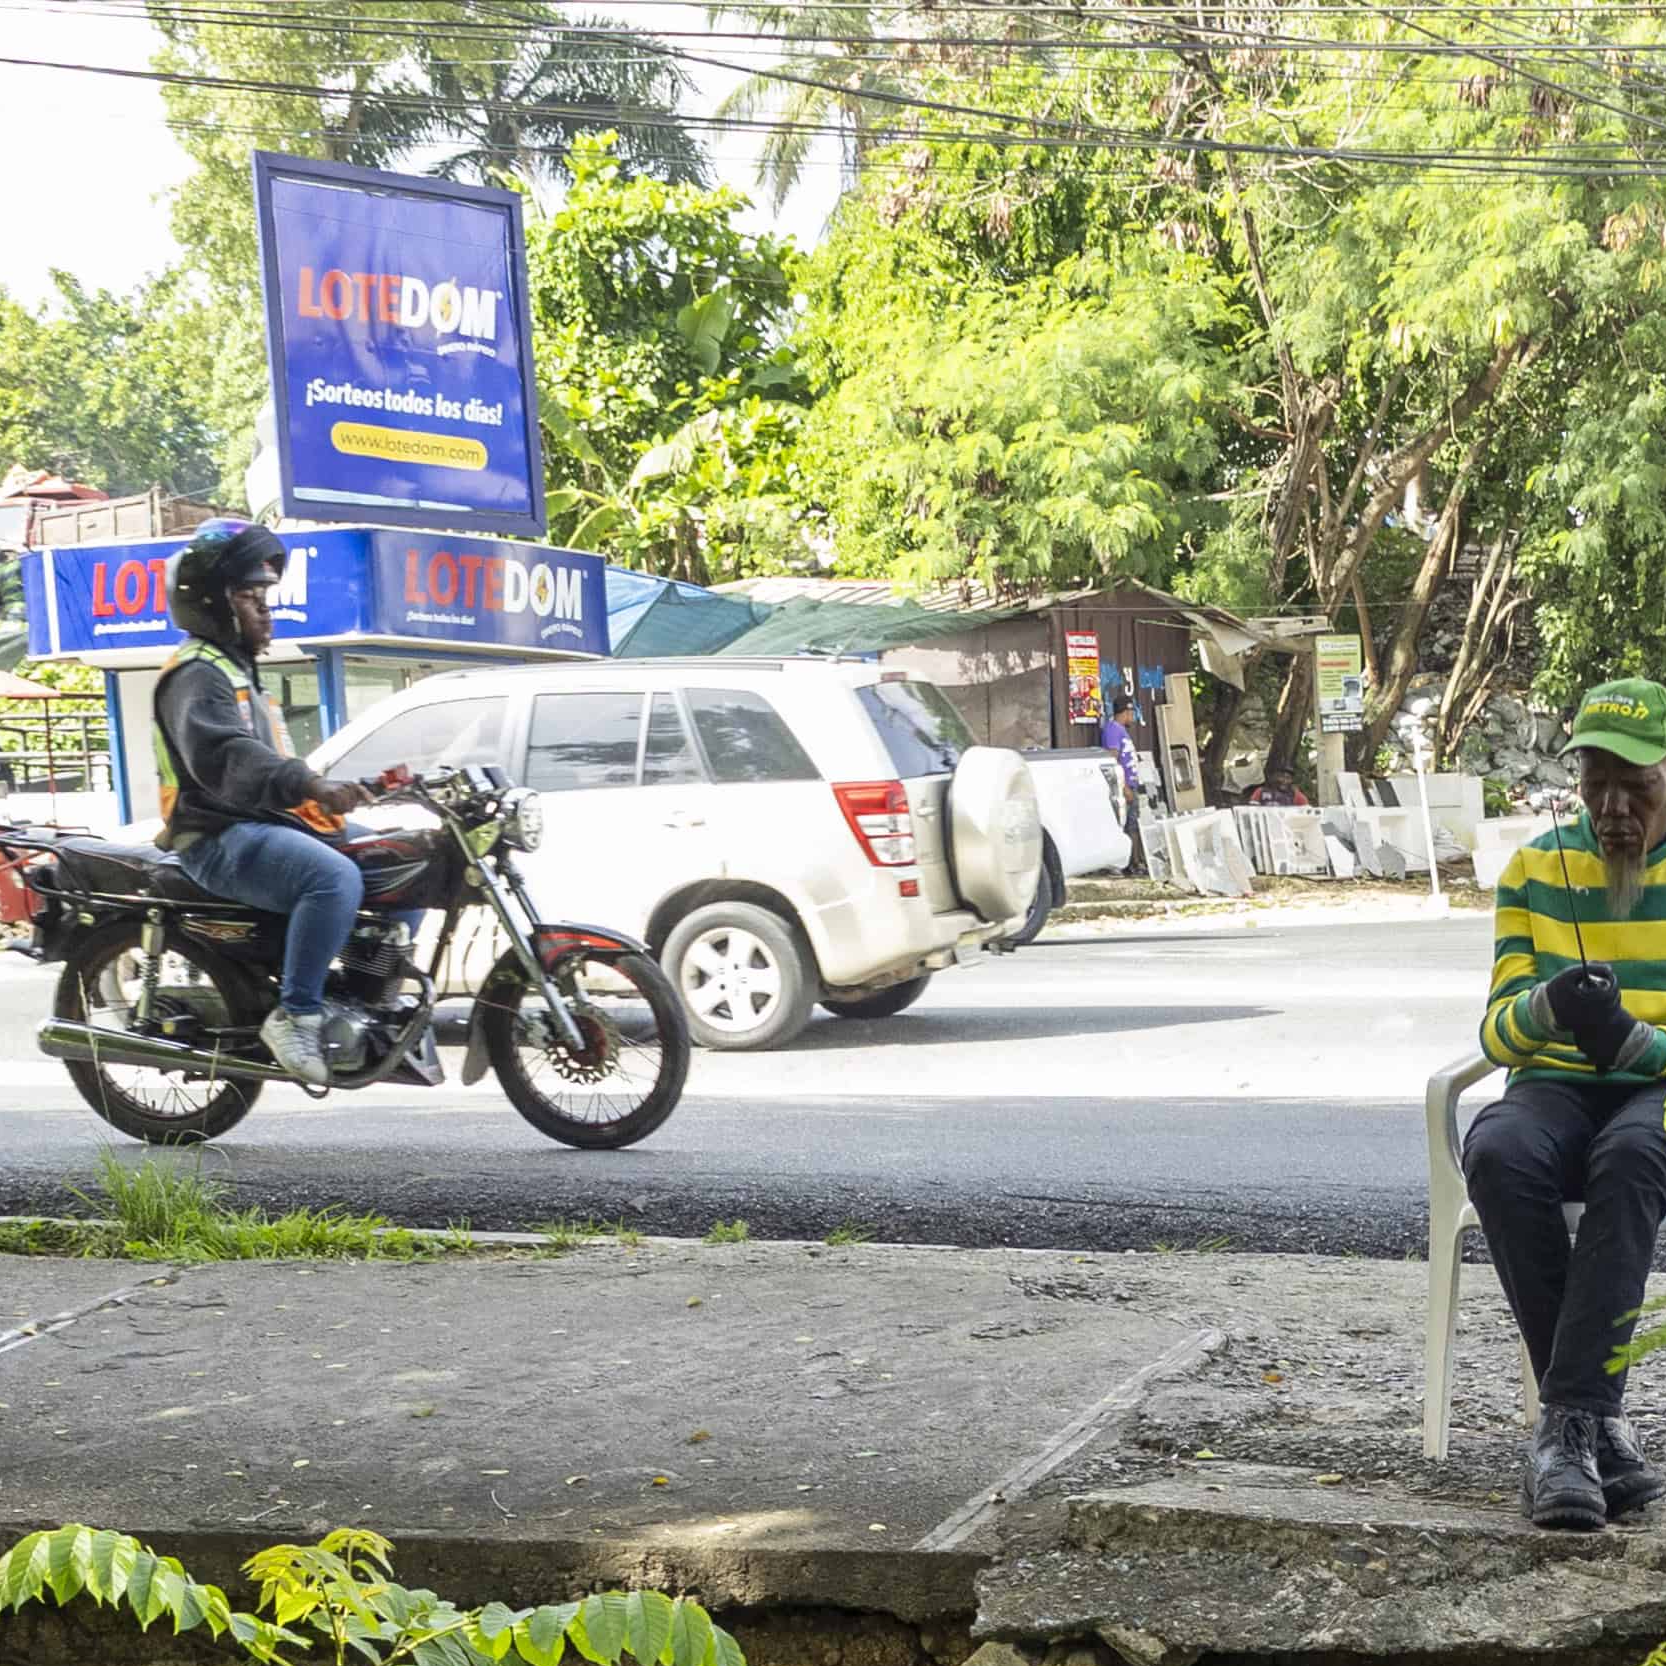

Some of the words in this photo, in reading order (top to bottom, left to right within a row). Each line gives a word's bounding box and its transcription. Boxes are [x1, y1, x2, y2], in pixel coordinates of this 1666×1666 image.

[297, 267, 497, 340] LOTEDOM
[306, 378, 383, 407] ¡Sorteos
[383, 388, 434, 417] todos
[435, 393, 461, 419] los
[463, 398, 503, 426] días!
[340, 432, 480, 462] www.lotedom.com
[404, 549, 582, 620] LOTEDOM
